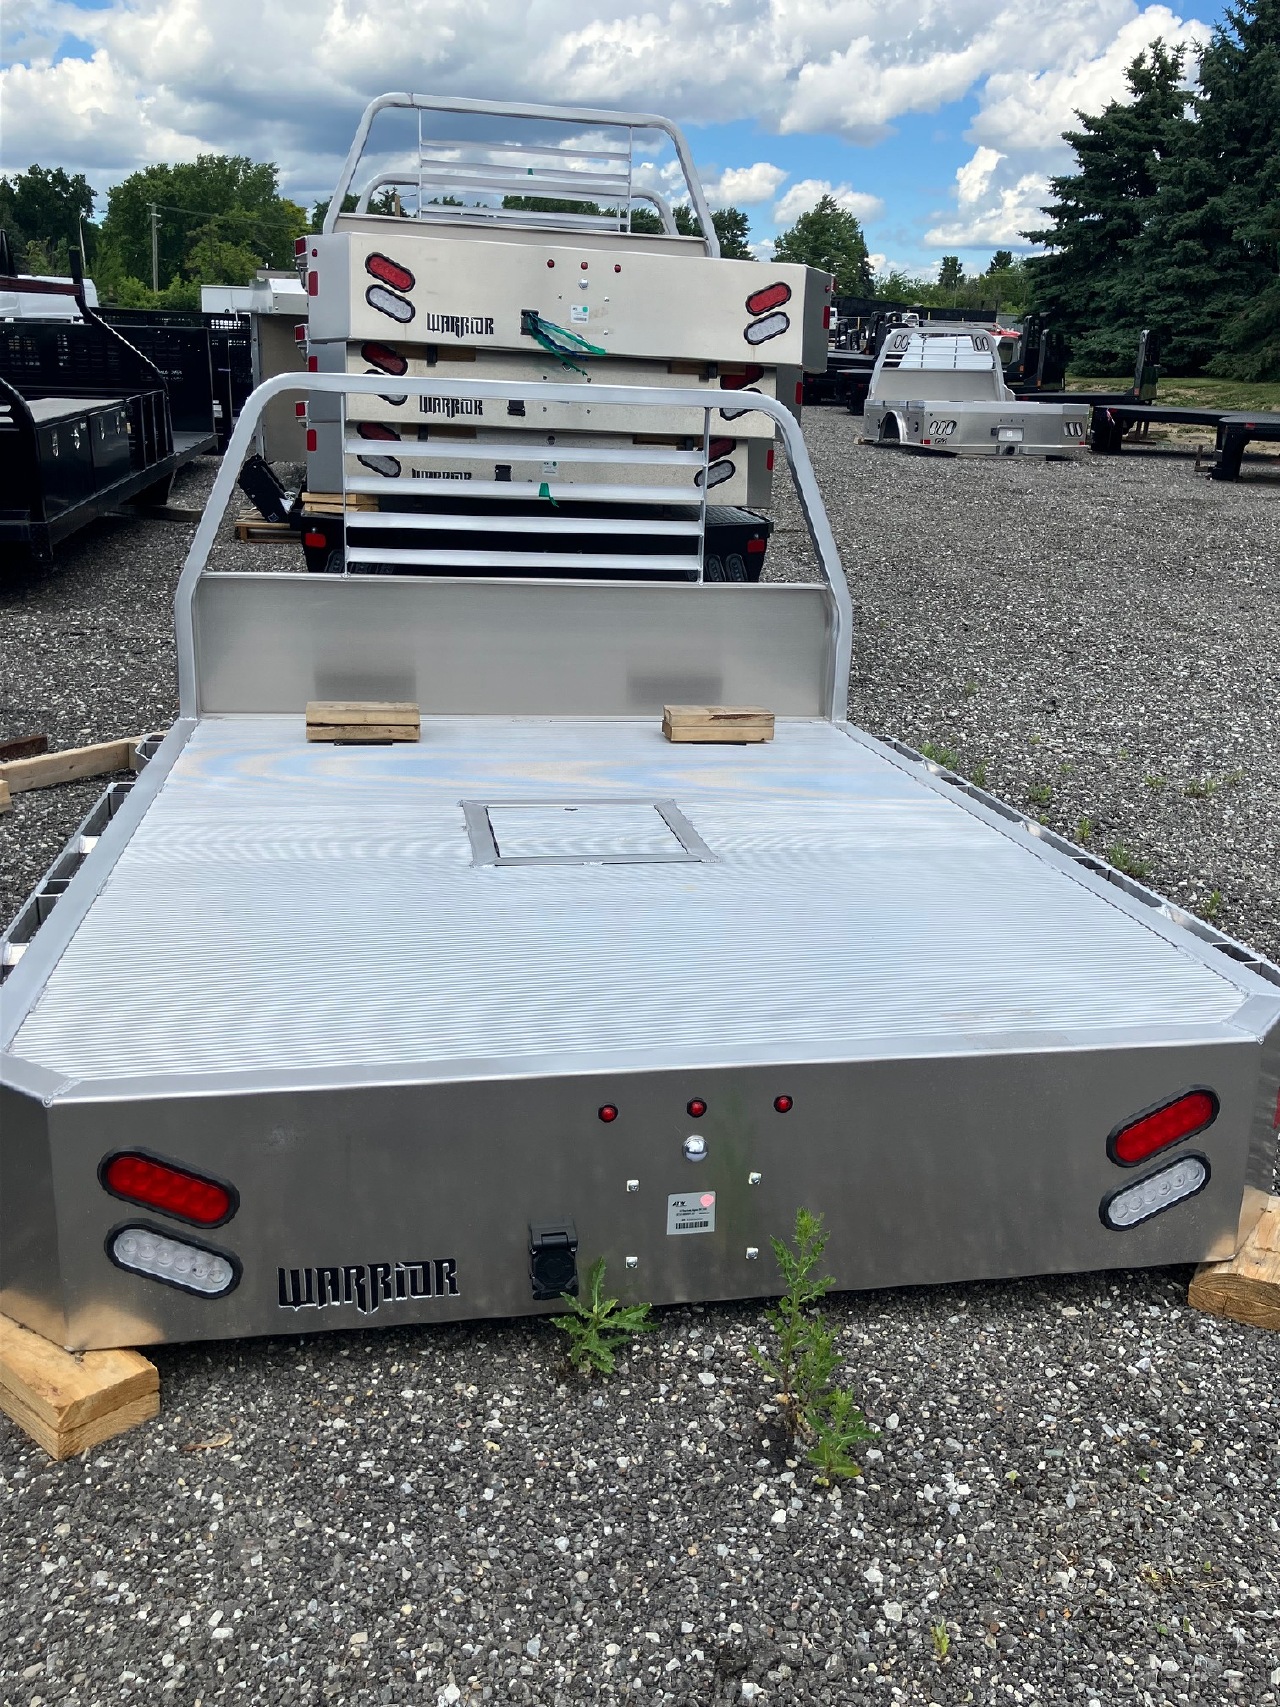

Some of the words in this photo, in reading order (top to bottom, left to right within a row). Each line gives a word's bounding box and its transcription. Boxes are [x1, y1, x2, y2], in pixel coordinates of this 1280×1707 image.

[427, 312, 494, 338] WARRIOR
[419, 395, 483, 418] WARRIOR
[277, 1258, 460, 1315] WARRIOR
